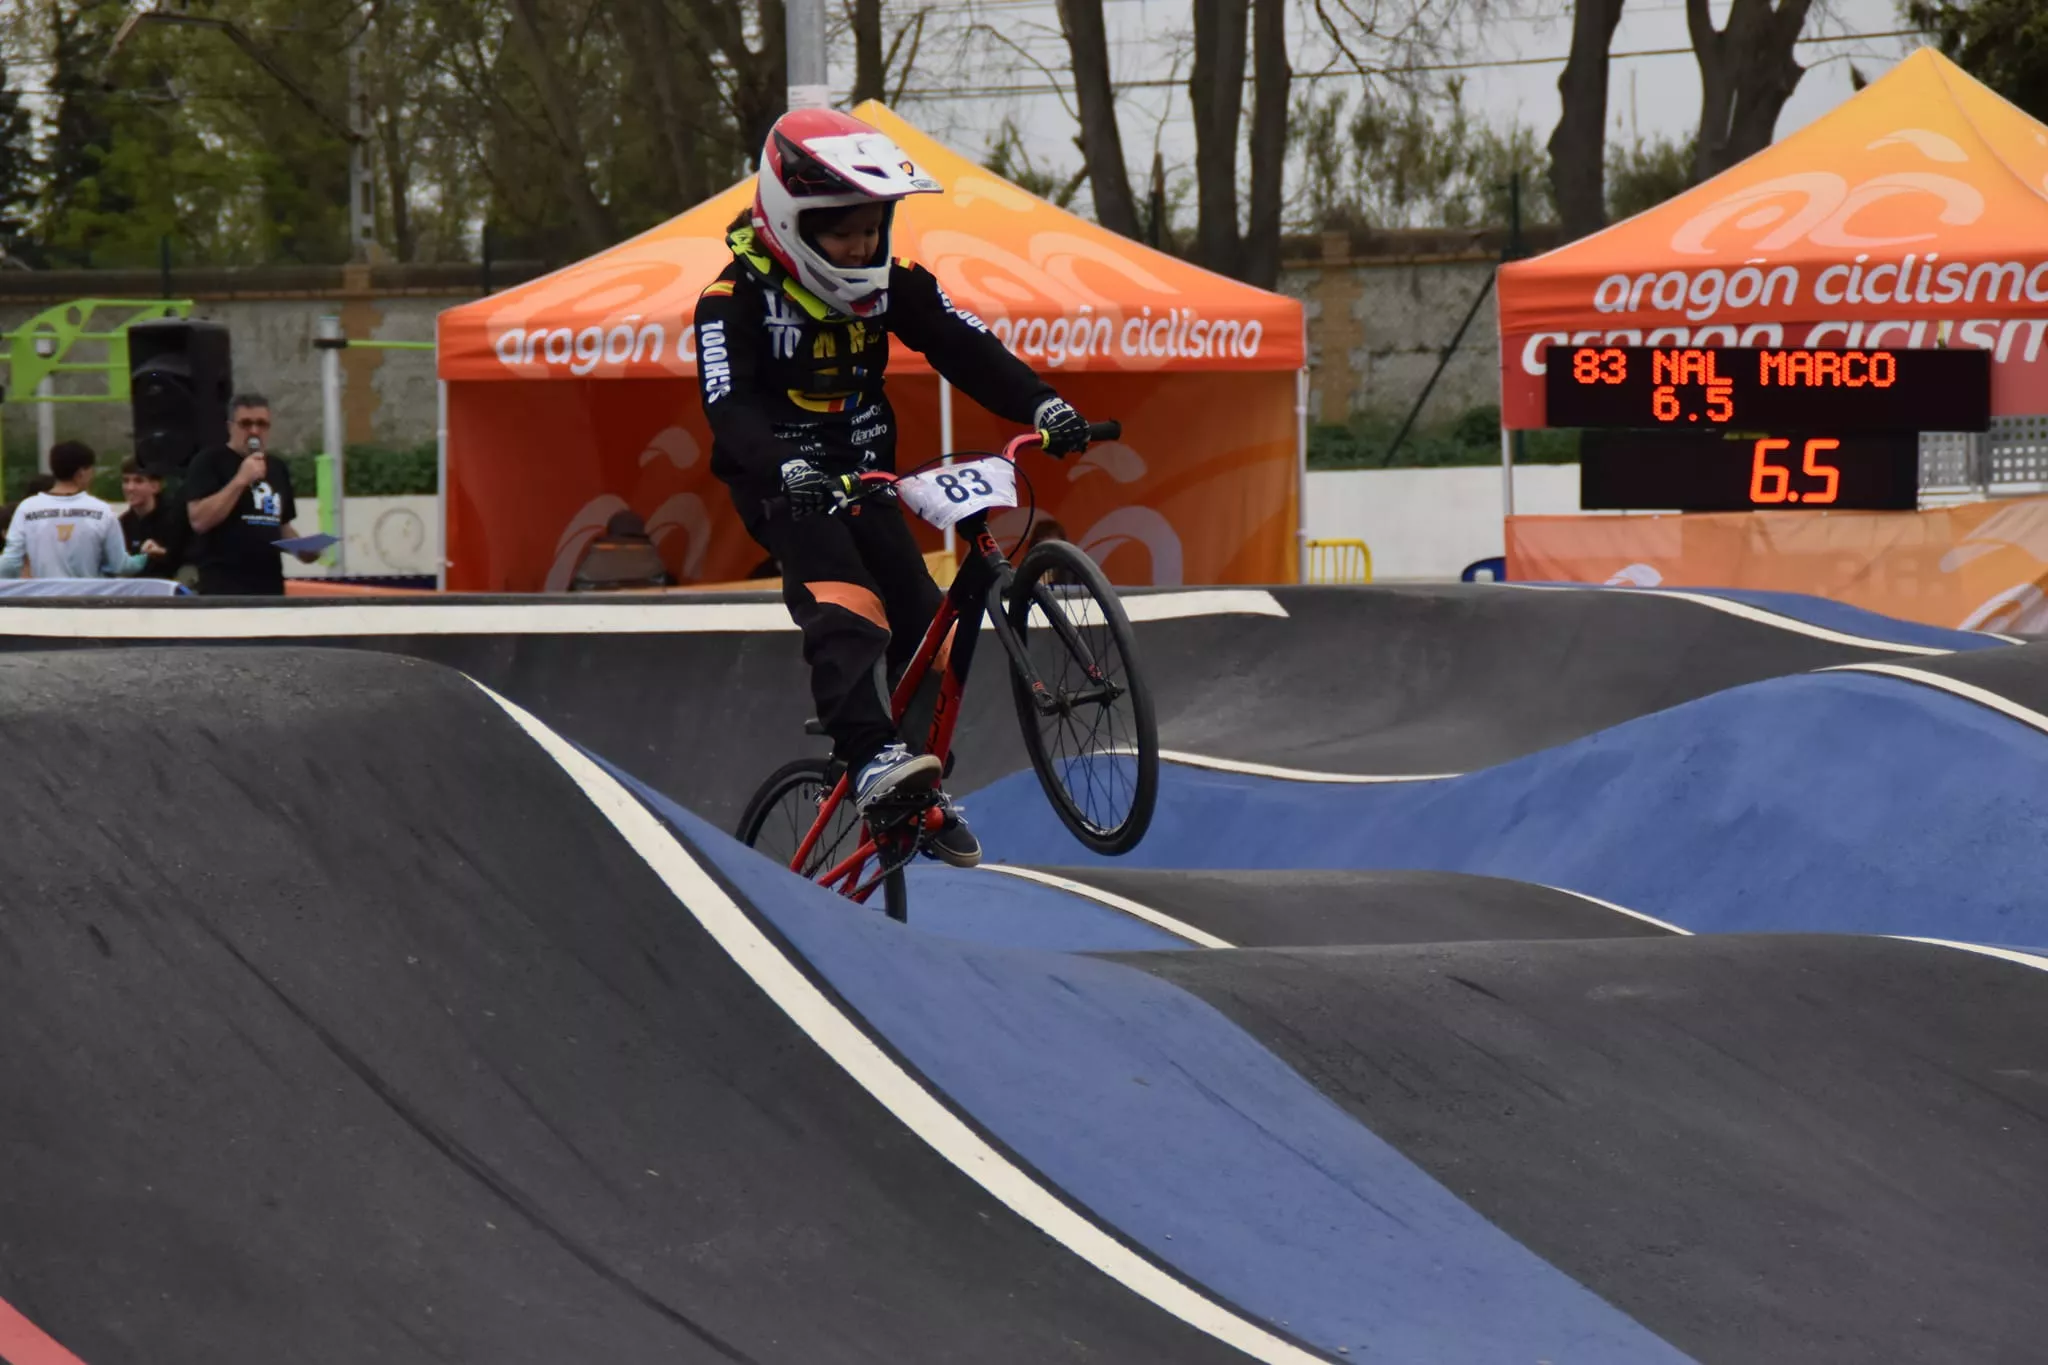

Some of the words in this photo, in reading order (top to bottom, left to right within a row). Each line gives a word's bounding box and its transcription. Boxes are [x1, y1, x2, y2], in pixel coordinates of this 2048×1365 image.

[1593, 257, 1799, 321] aragón
[496, 313, 665, 375] aragón
[1120, 305, 1263, 358] ciclismo
[701, 319, 732, 404] SCHOOL
[1573, 349, 1627, 385] 83
[1653, 350, 1733, 386] NAL
[1760, 351, 1896, 387] MARCO
[1653, 386, 1733, 422] 6.5
[934, 467, 994, 504] 83
[1750, 438, 1840, 503] 6.5
